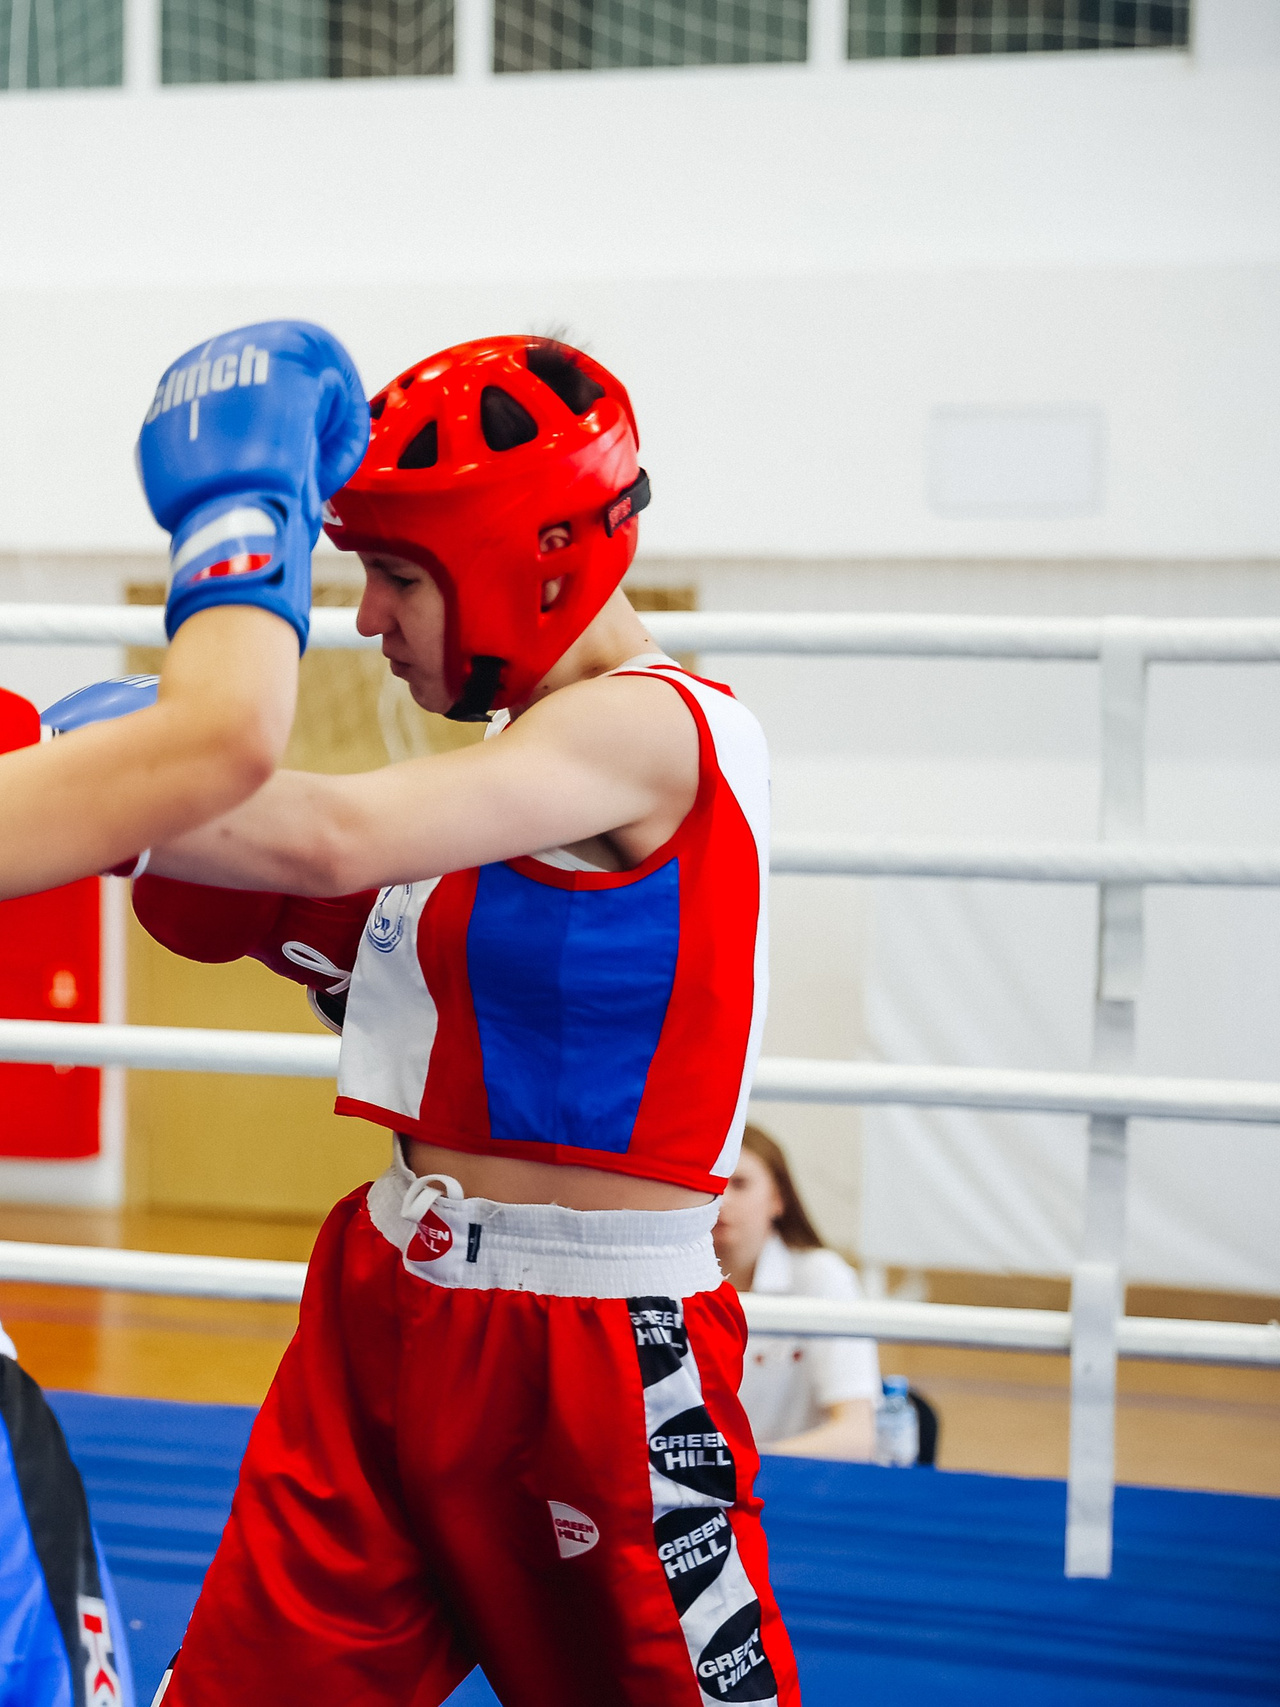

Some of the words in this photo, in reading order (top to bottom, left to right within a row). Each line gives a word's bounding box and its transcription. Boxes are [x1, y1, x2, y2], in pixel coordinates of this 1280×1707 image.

[664, 1449, 731, 1471] HILL
[554, 1518, 594, 1534] GREEN
[557, 1527, 589, 1544] HILL
[658, 1513, 728, 1561] GREEN
[664, 1538, 728, 1580] HILL
[717, 1648, 765, 1693] HILL
